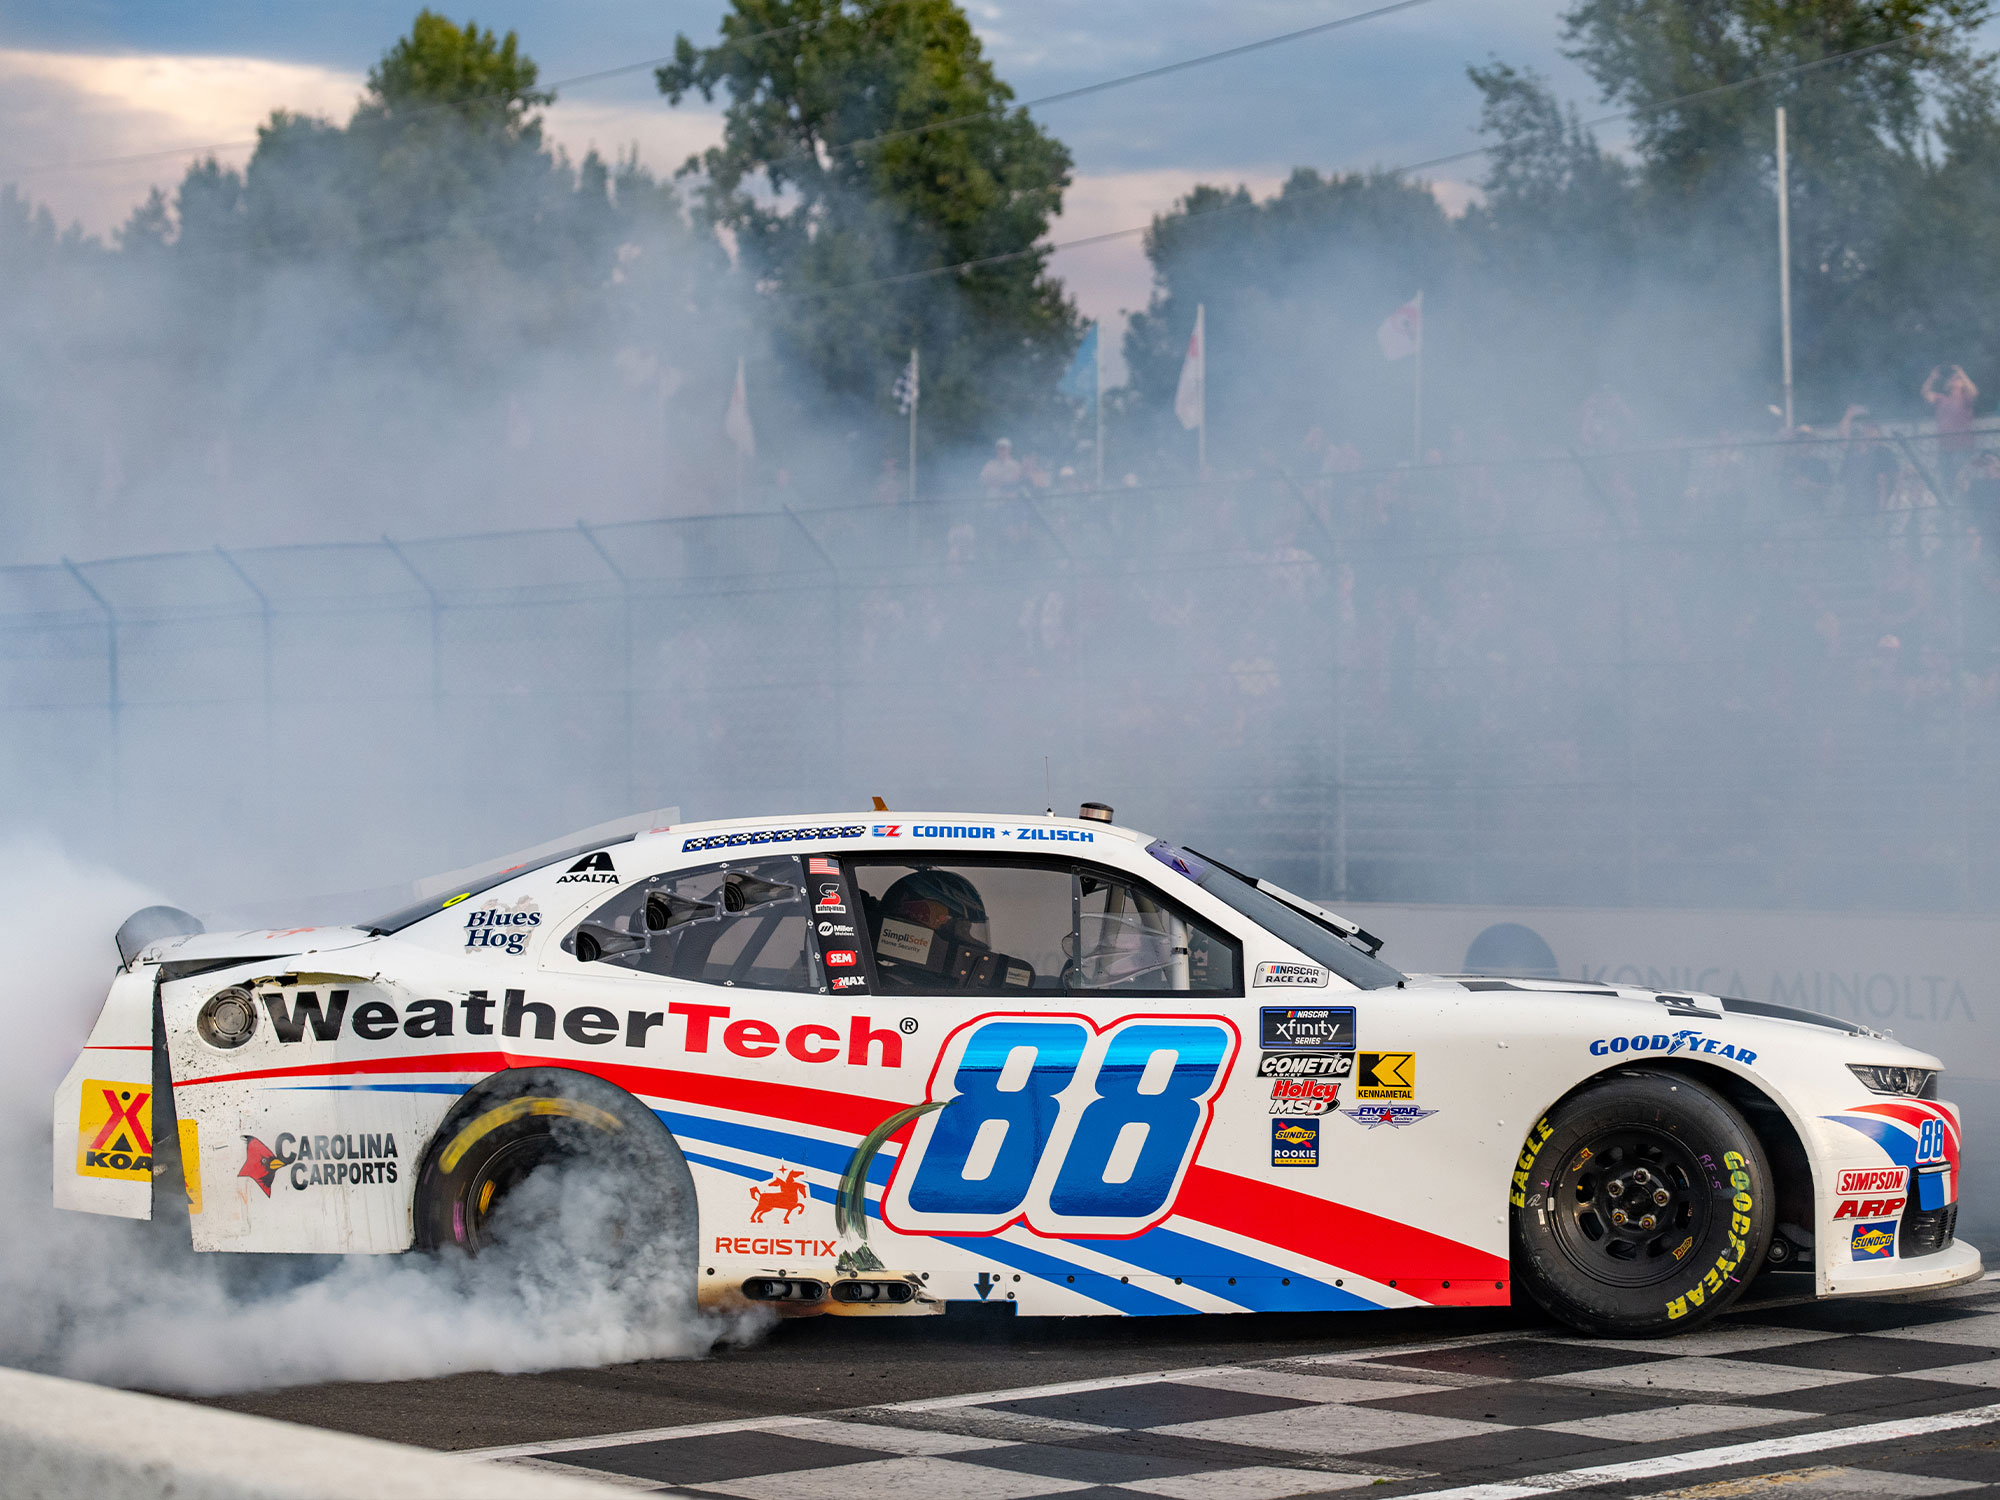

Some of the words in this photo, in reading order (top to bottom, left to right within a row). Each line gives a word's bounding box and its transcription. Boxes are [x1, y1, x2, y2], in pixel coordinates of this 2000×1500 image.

[912, 825, 996, 839] CONNOR
[1016, 828, 1095, 843] ZILISCH
[556, 873, 620, 885] AXALTA
[464, 908, 543, 929] Blues
[833, 925, 854, 933] Miller
[882, 928, 929, 948] SimpliSafe
[465, 929, 527, 955] Hog
[830, 953, 853, 964] SEM
[1265, 975, 1294, 984] RACE
[1296, 976, 1318, 984] CAR
[1279, 965, 1320, 977] NASCAR
[1769, 968, 1978, 1025] MINOLTA
[1296, 1010, 1329, 1018] NASCAR
[1276, 1018, 1340, 1041] xfinity
[1294, 1036, 1322, 1045] SERIES
[1589, 1030, 1758, 1066] GOODYEAR
[1261, 1056, 1352, 1075] COMETIC
[1272, 1079, 1340, 1102] Holley
[1357, 1089, 1413, 1099] KENNAMETAL
[1269, 1099, 1329, 1115] MSD
[1359, 1107, 1387, 1116] FIVE
[1389, 1107, 1419, 1116] STAR
[900, 1017, 1234, 1228] 88
[1277, 1130, 1316, 1140] SUNOCO
[1916, 1118, 1944, 1161] 88
[274, 1132, 398, 1163] CAROLINA
[1274, 1149, 1317, 1158] ROOKIE
[85, 1151, 152, 1172] KOA
[1509, 1117, 1554, 1208] EAGLE
[290, 1161, 398, 1191] CARPORTS
[1841, 1170, 1905, 1192] SIMPSON
[1834, 1197, 1906, 1219] ARP
[715, 1236, 837, 1257] REGISTIX
[1853, 1234, 1894, 1249] SUNOCO
